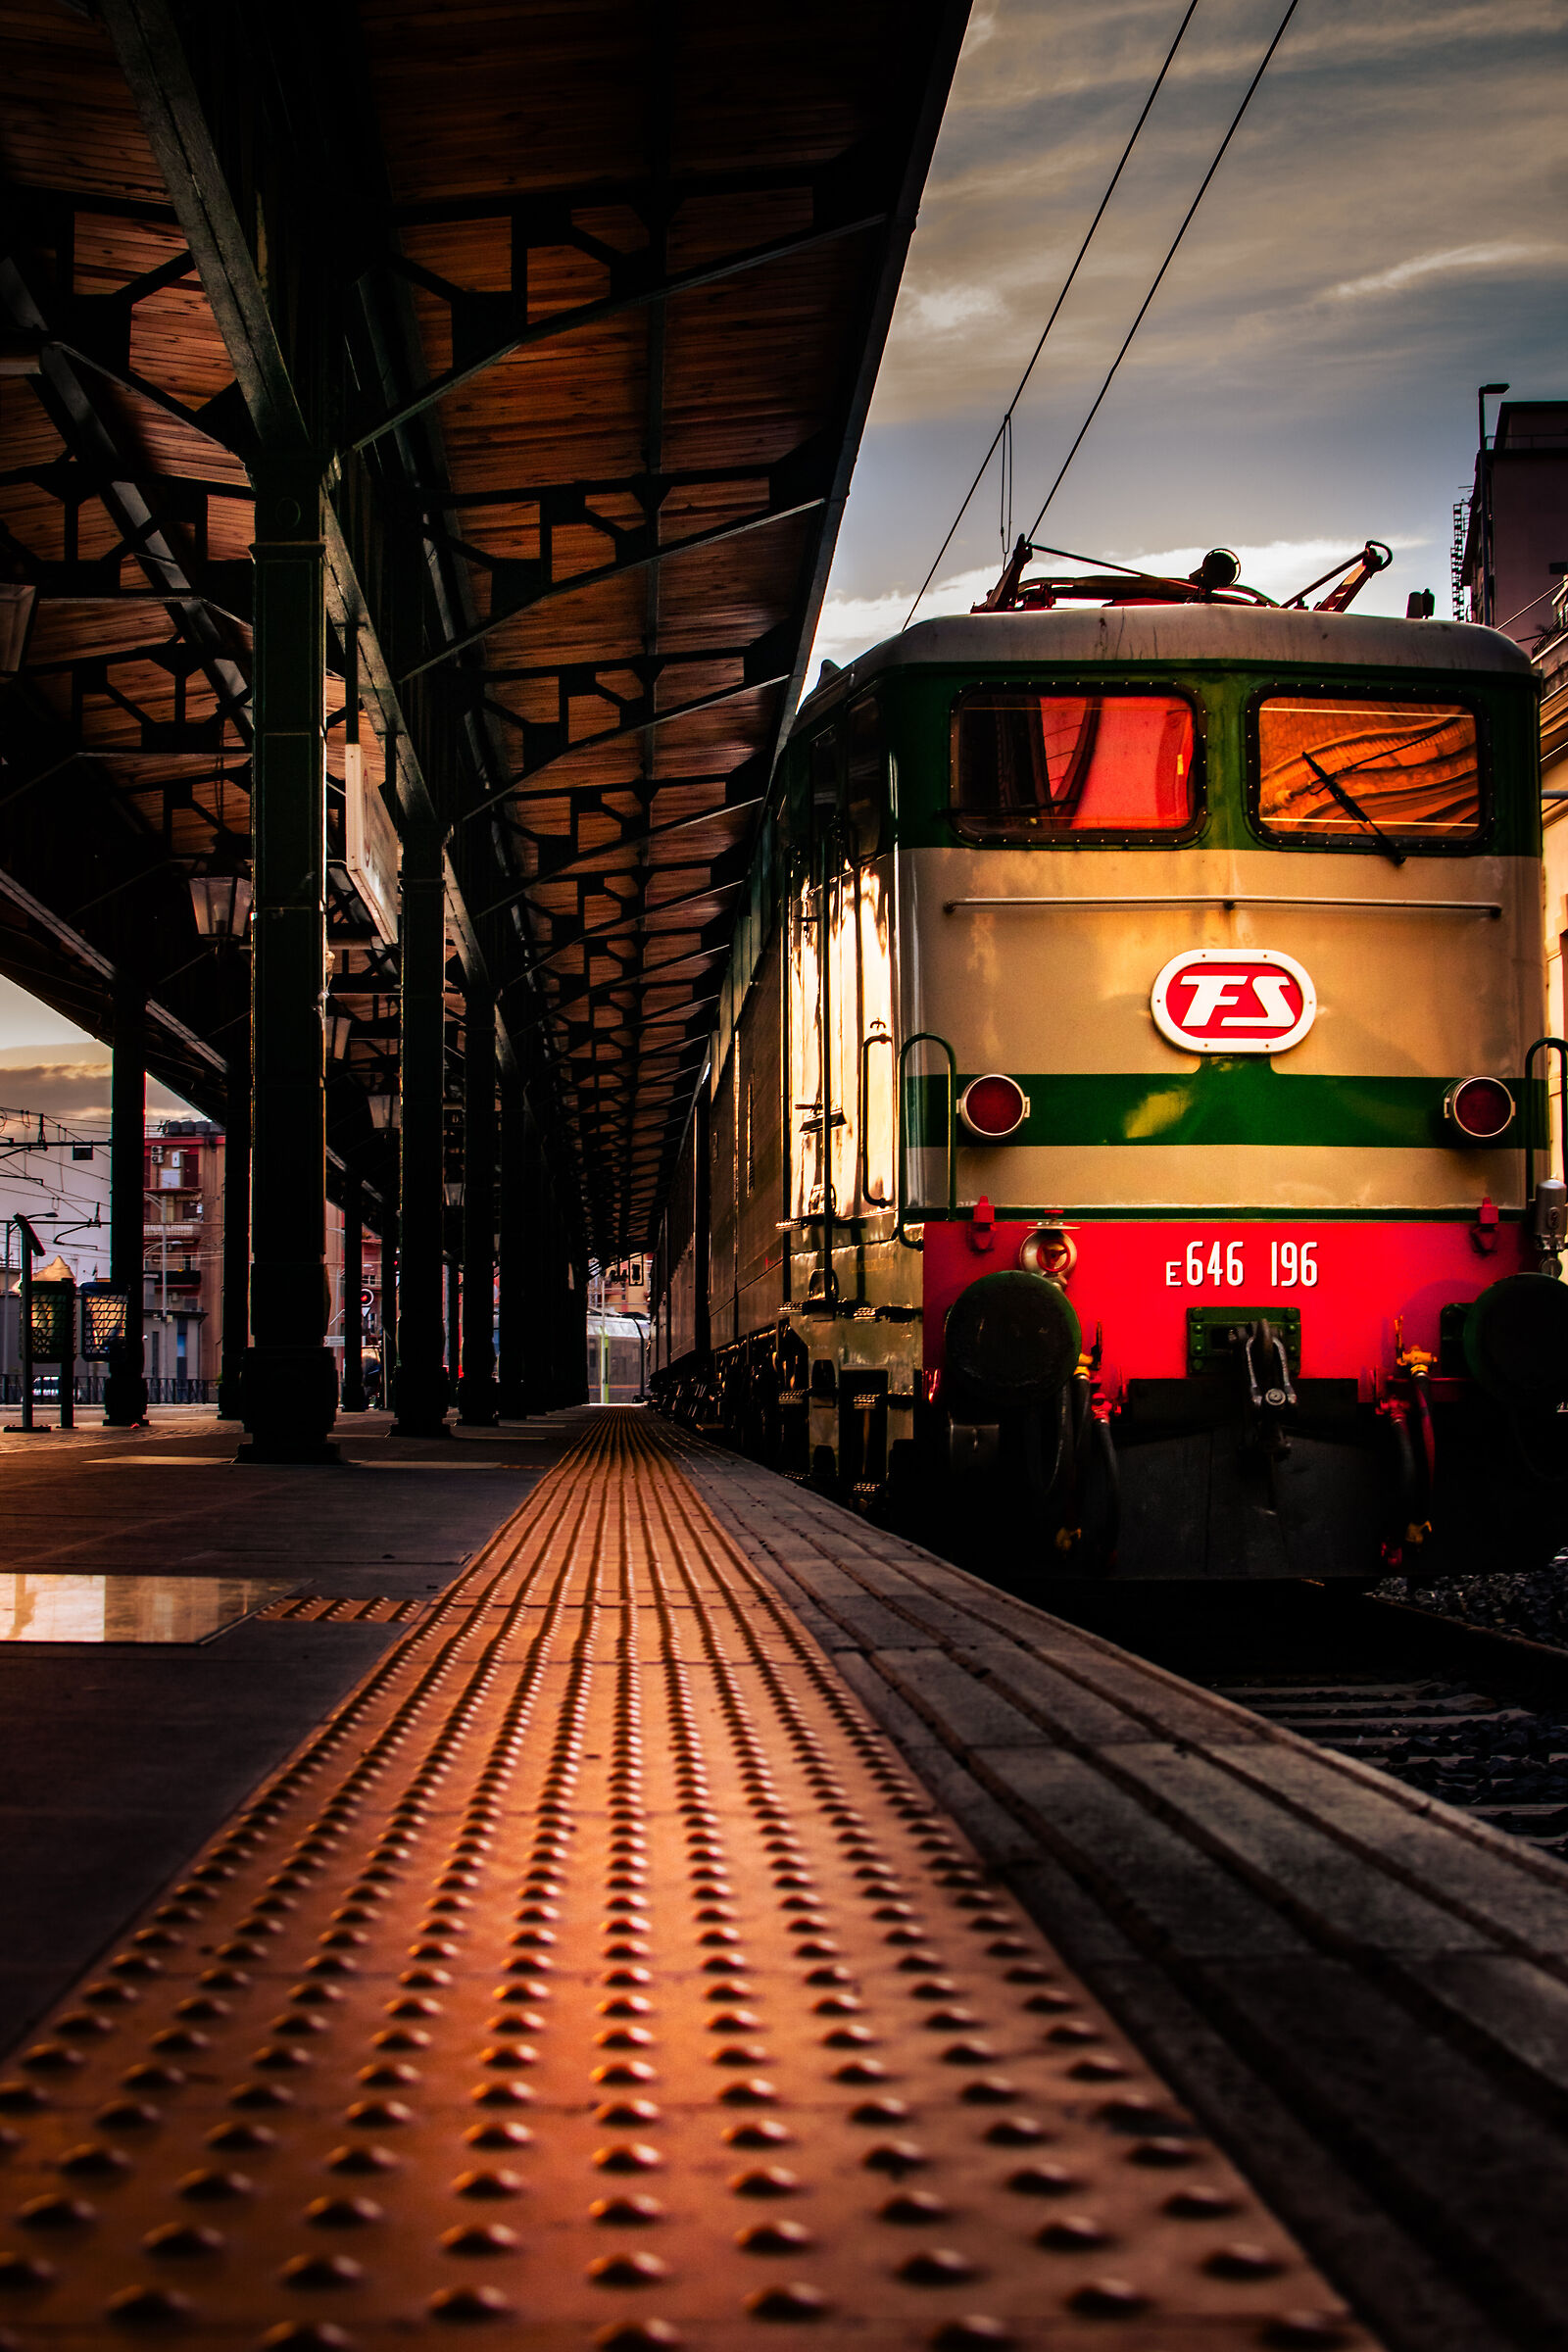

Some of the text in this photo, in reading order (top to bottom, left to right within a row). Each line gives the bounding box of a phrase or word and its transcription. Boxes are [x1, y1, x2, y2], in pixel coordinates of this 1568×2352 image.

[1180, 975, 1296, 1027] FS
[1166, 1241, 1318, 1287] E646 196
